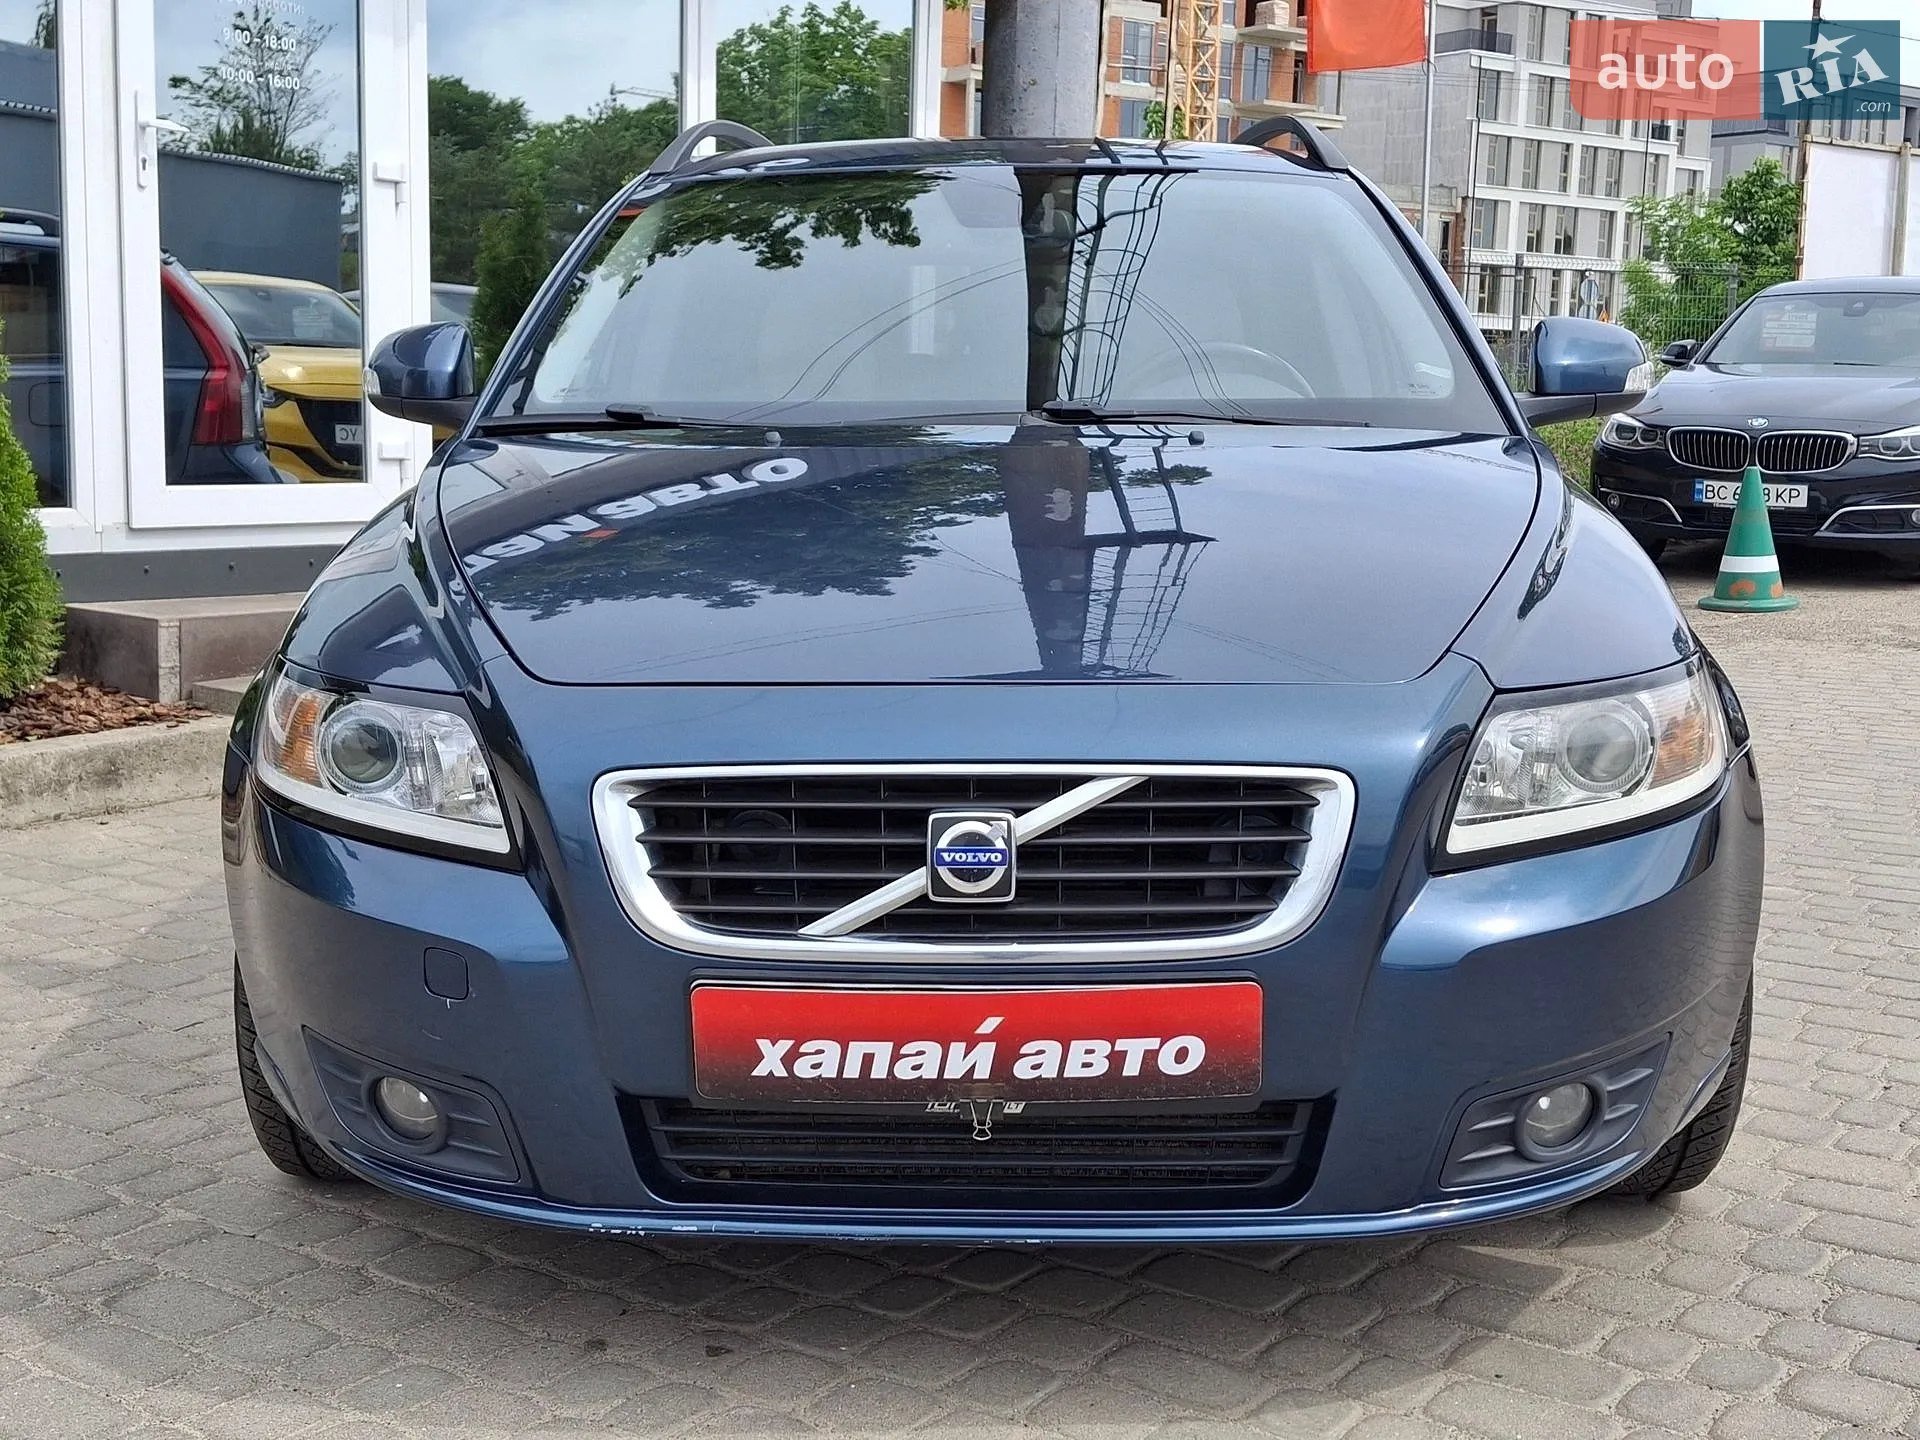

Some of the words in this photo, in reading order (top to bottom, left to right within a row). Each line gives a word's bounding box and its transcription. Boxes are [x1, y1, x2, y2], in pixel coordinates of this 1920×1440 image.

[223, 27, 251, 44] 9:00
[263, 35, 296, 51] 18:00
[221, 66, 254, 84] 10:00
[268, 73, 300, 90] 16:00
[1705, 484, 1728, 500] BC
[1733, 486, 1771, 502] 68
[1776, 488, 1801, 504] KP
[940, 852, 1003, 863] VOLVO
[1012, 1034, 1206, 1079] авто
